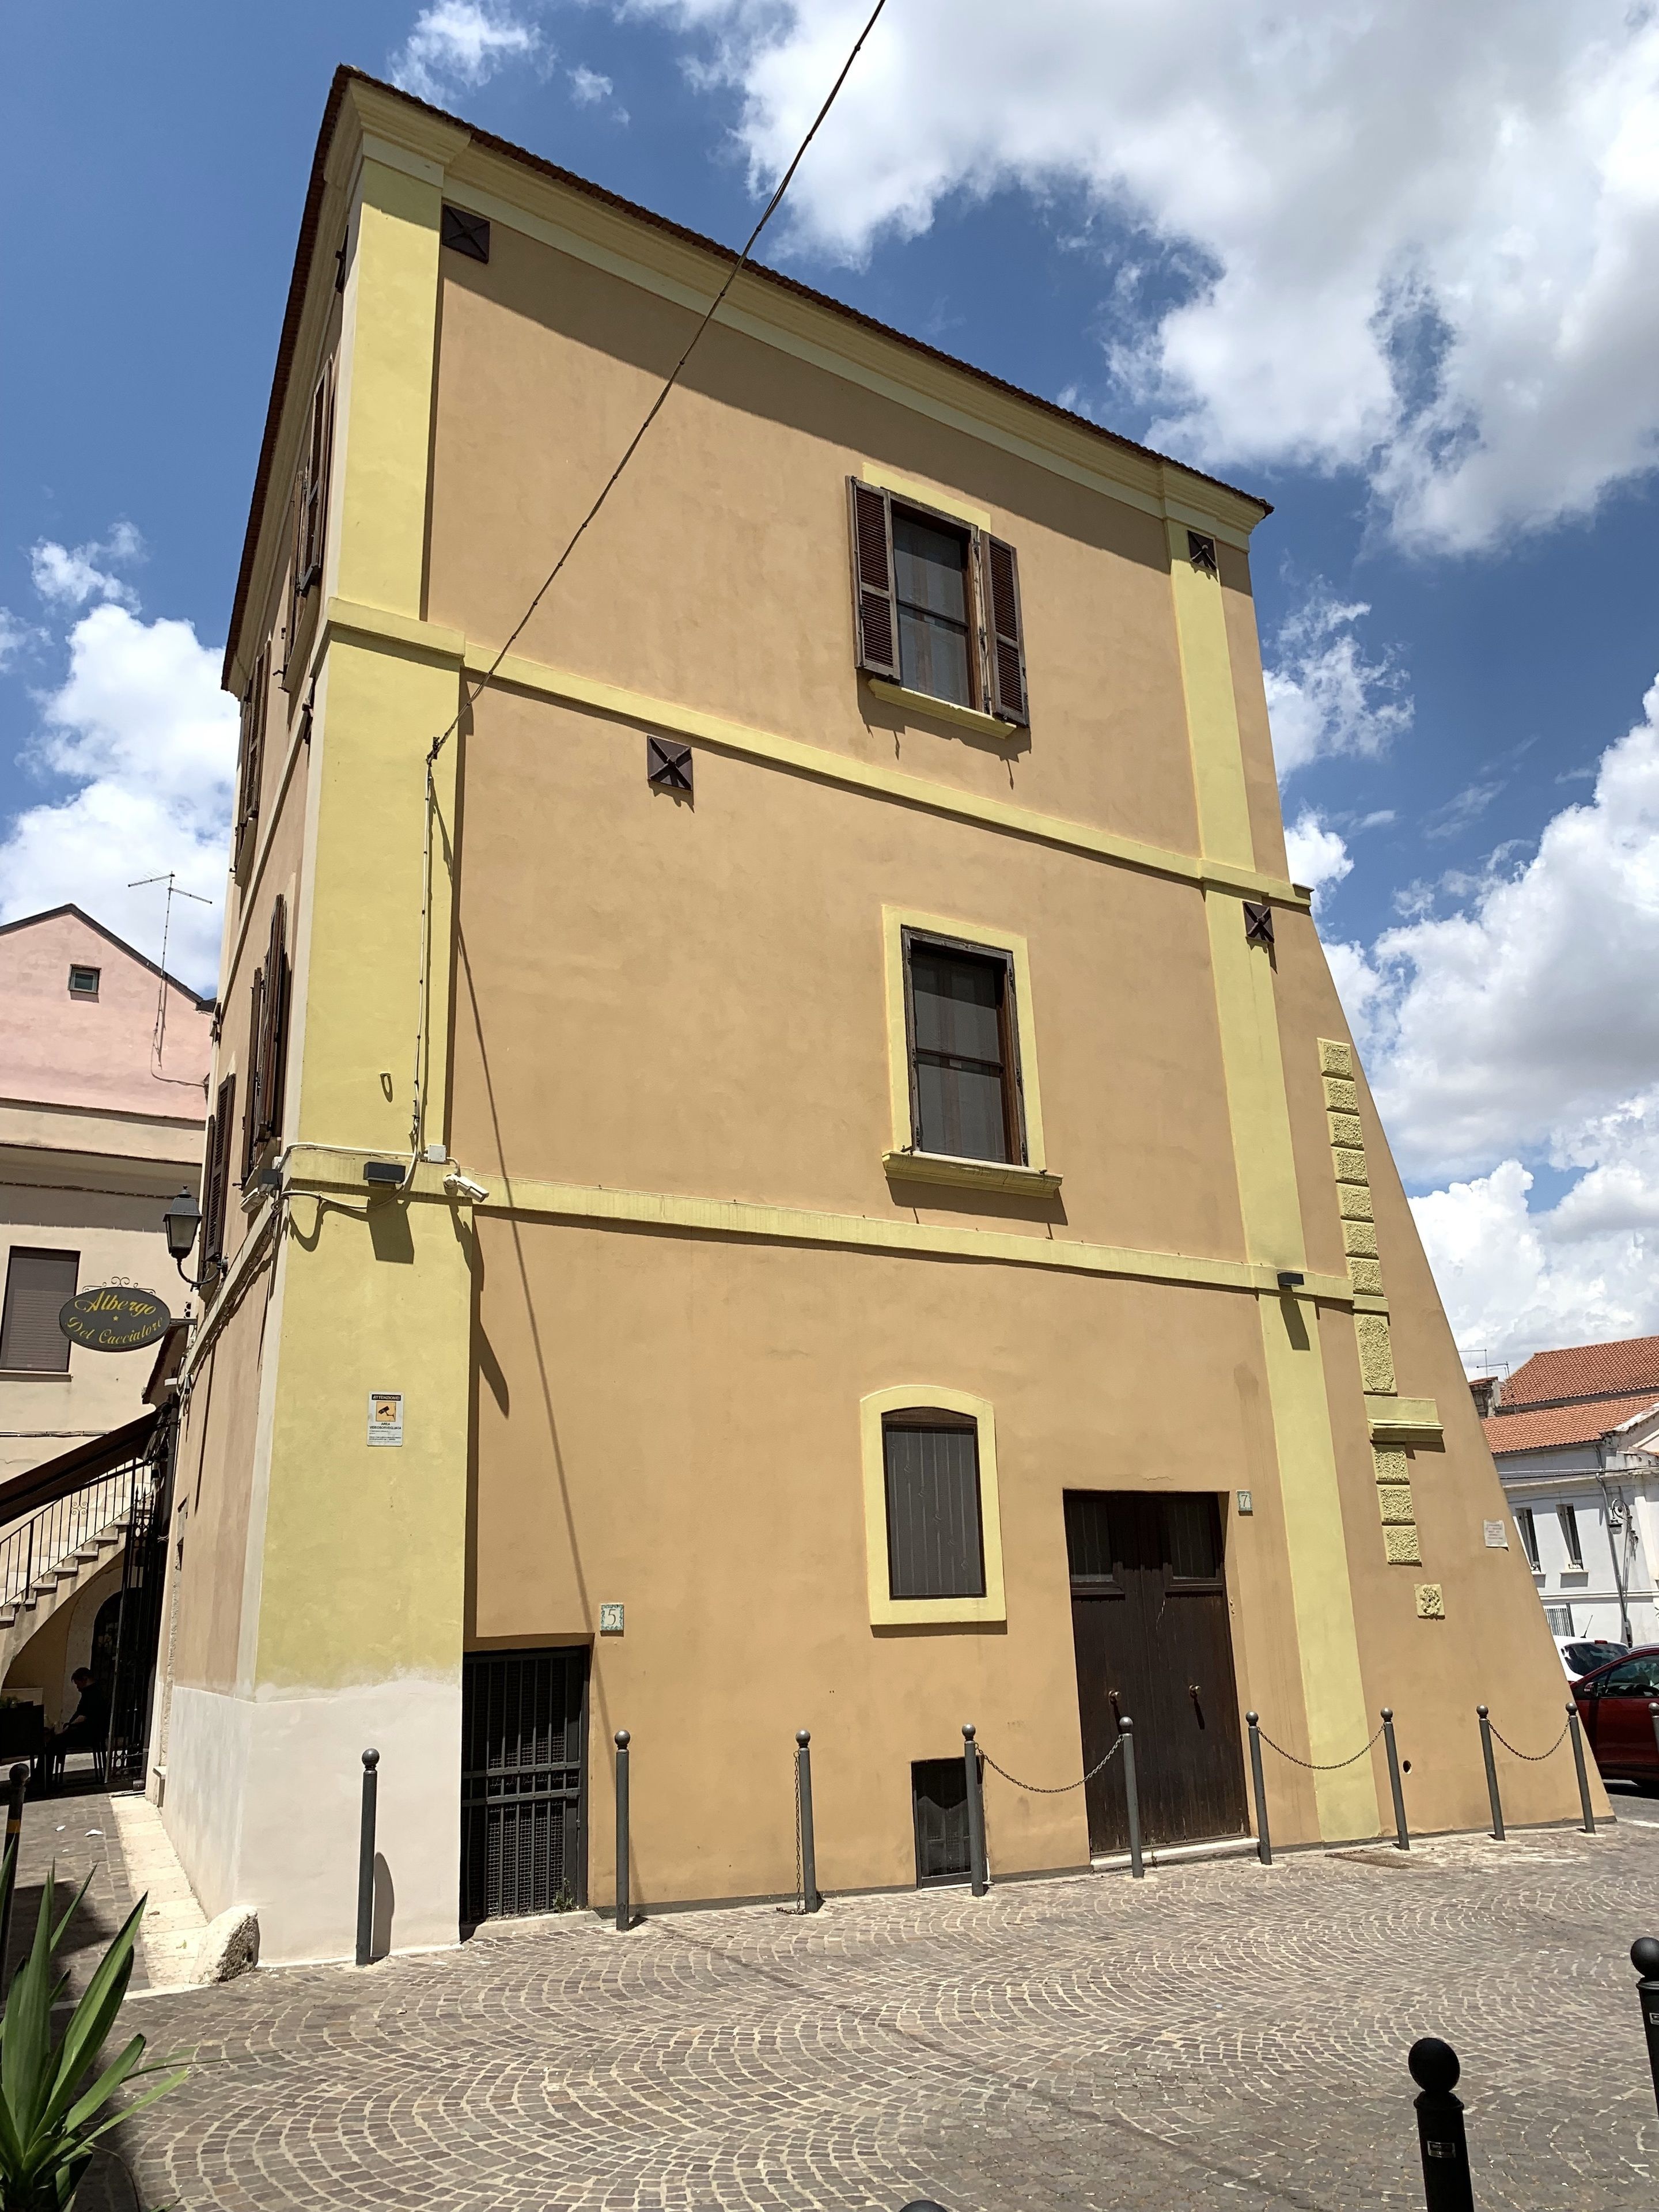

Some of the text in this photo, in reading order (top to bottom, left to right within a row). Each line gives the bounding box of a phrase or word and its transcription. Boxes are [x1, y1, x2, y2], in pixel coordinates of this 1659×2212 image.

[74, 1290, 157, 1317] Albergo
[66, 1317, 95, 1339] Del
[1241, 1495, 1248, 1507] 7
[607, 1609, 616, 1626] 5
